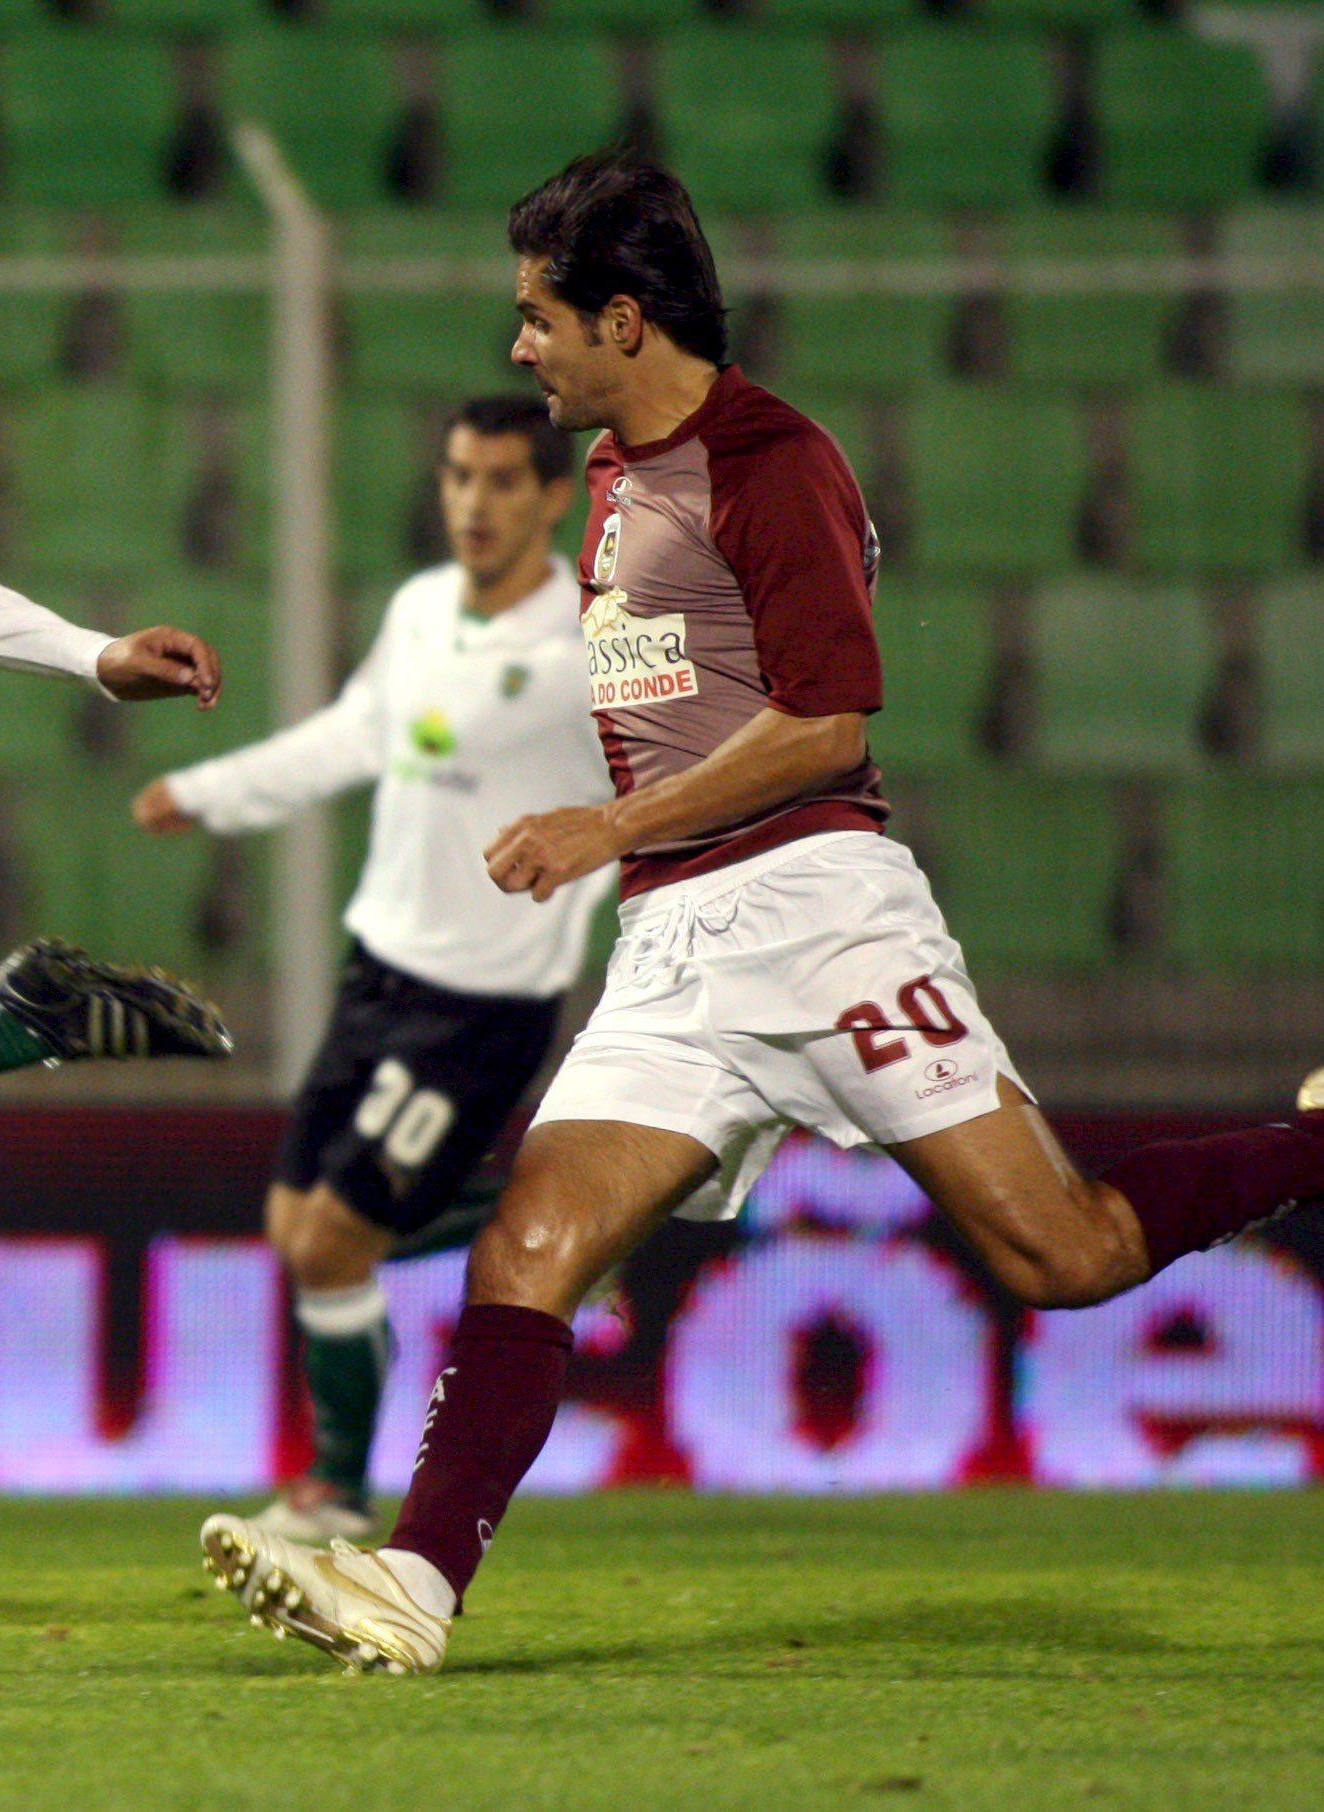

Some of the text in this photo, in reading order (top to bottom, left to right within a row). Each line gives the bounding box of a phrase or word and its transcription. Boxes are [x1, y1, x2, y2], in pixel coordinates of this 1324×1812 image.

[598, 681, 615, 704] DO
[620, 669, 694, 701] CONDE
[835, 974, 969, 1074] 20
